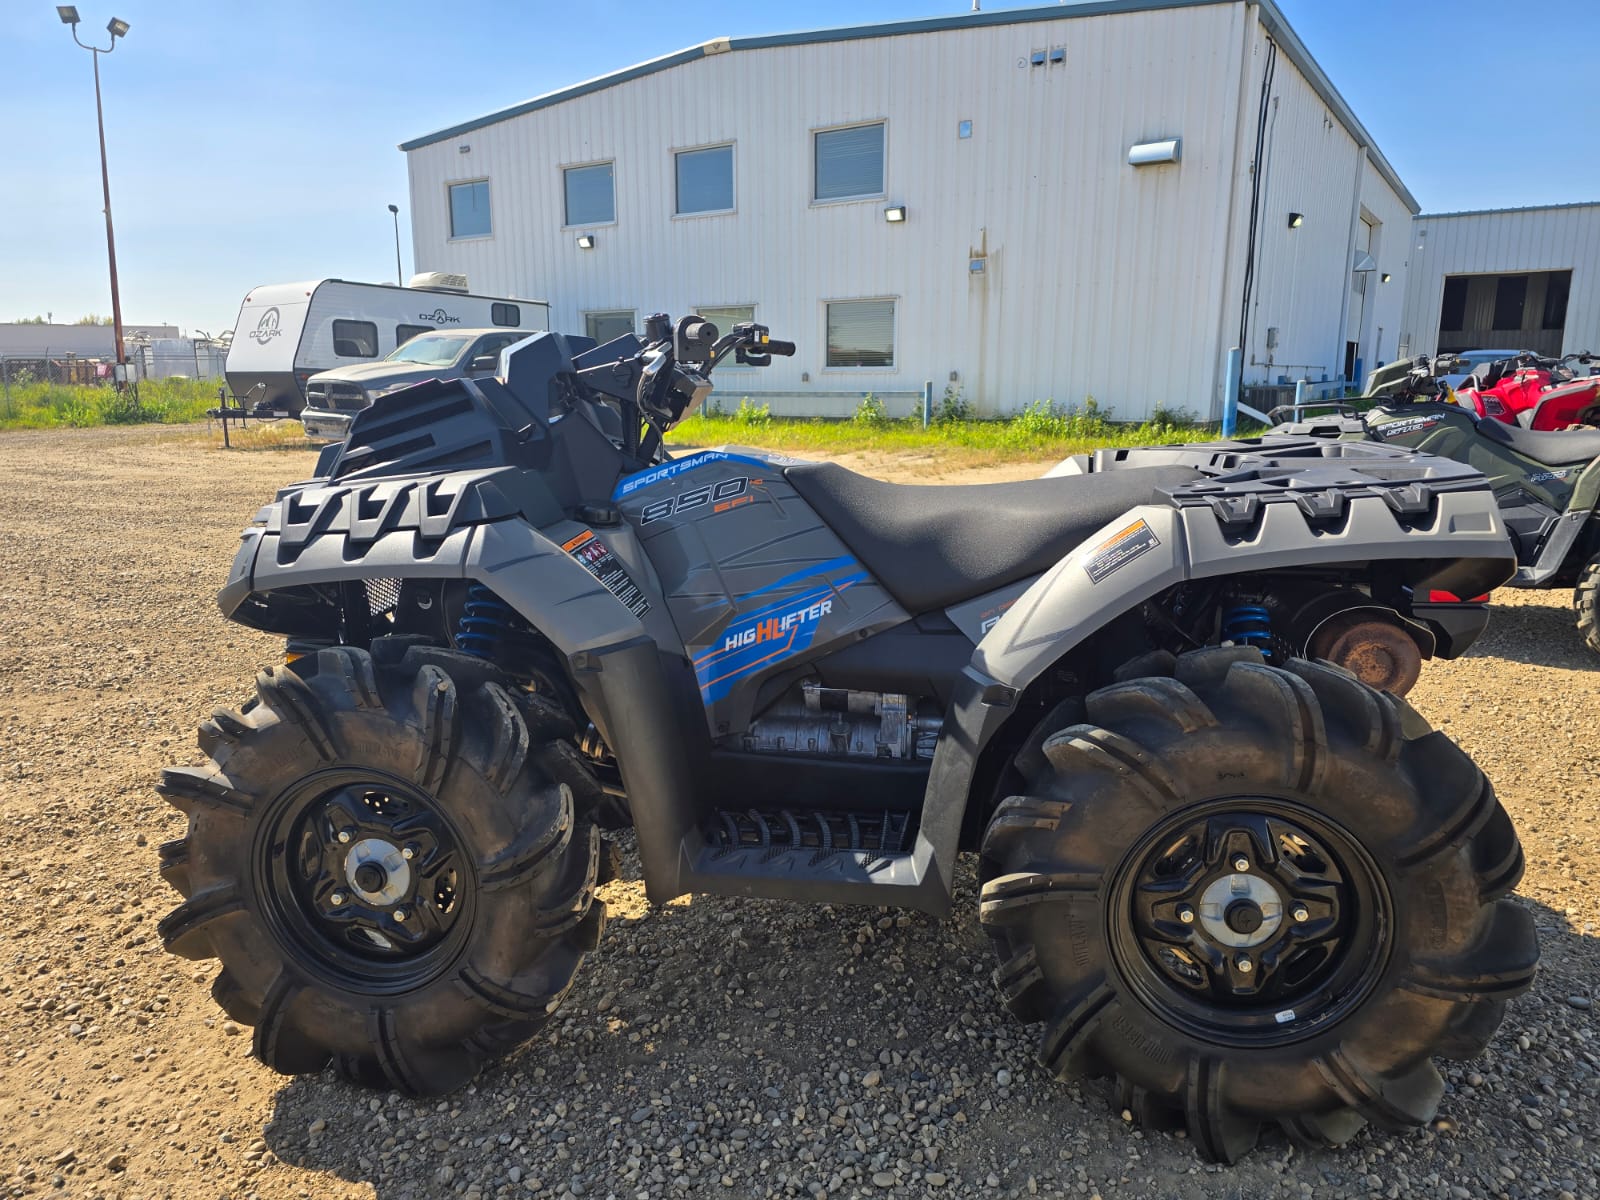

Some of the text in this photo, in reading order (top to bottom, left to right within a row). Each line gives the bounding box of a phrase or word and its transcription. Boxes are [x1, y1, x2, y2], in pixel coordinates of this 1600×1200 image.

[419, 313, 461, 324] OZARK
[249, 329, 282, 338] OZARK
[1377, 413, 1446, 431] SPORTSMAN
[622, 452, 729, 494] SPORTSMAN
[641, 476, 749, 526] 850
[714, 495, 754, 513] EFI
